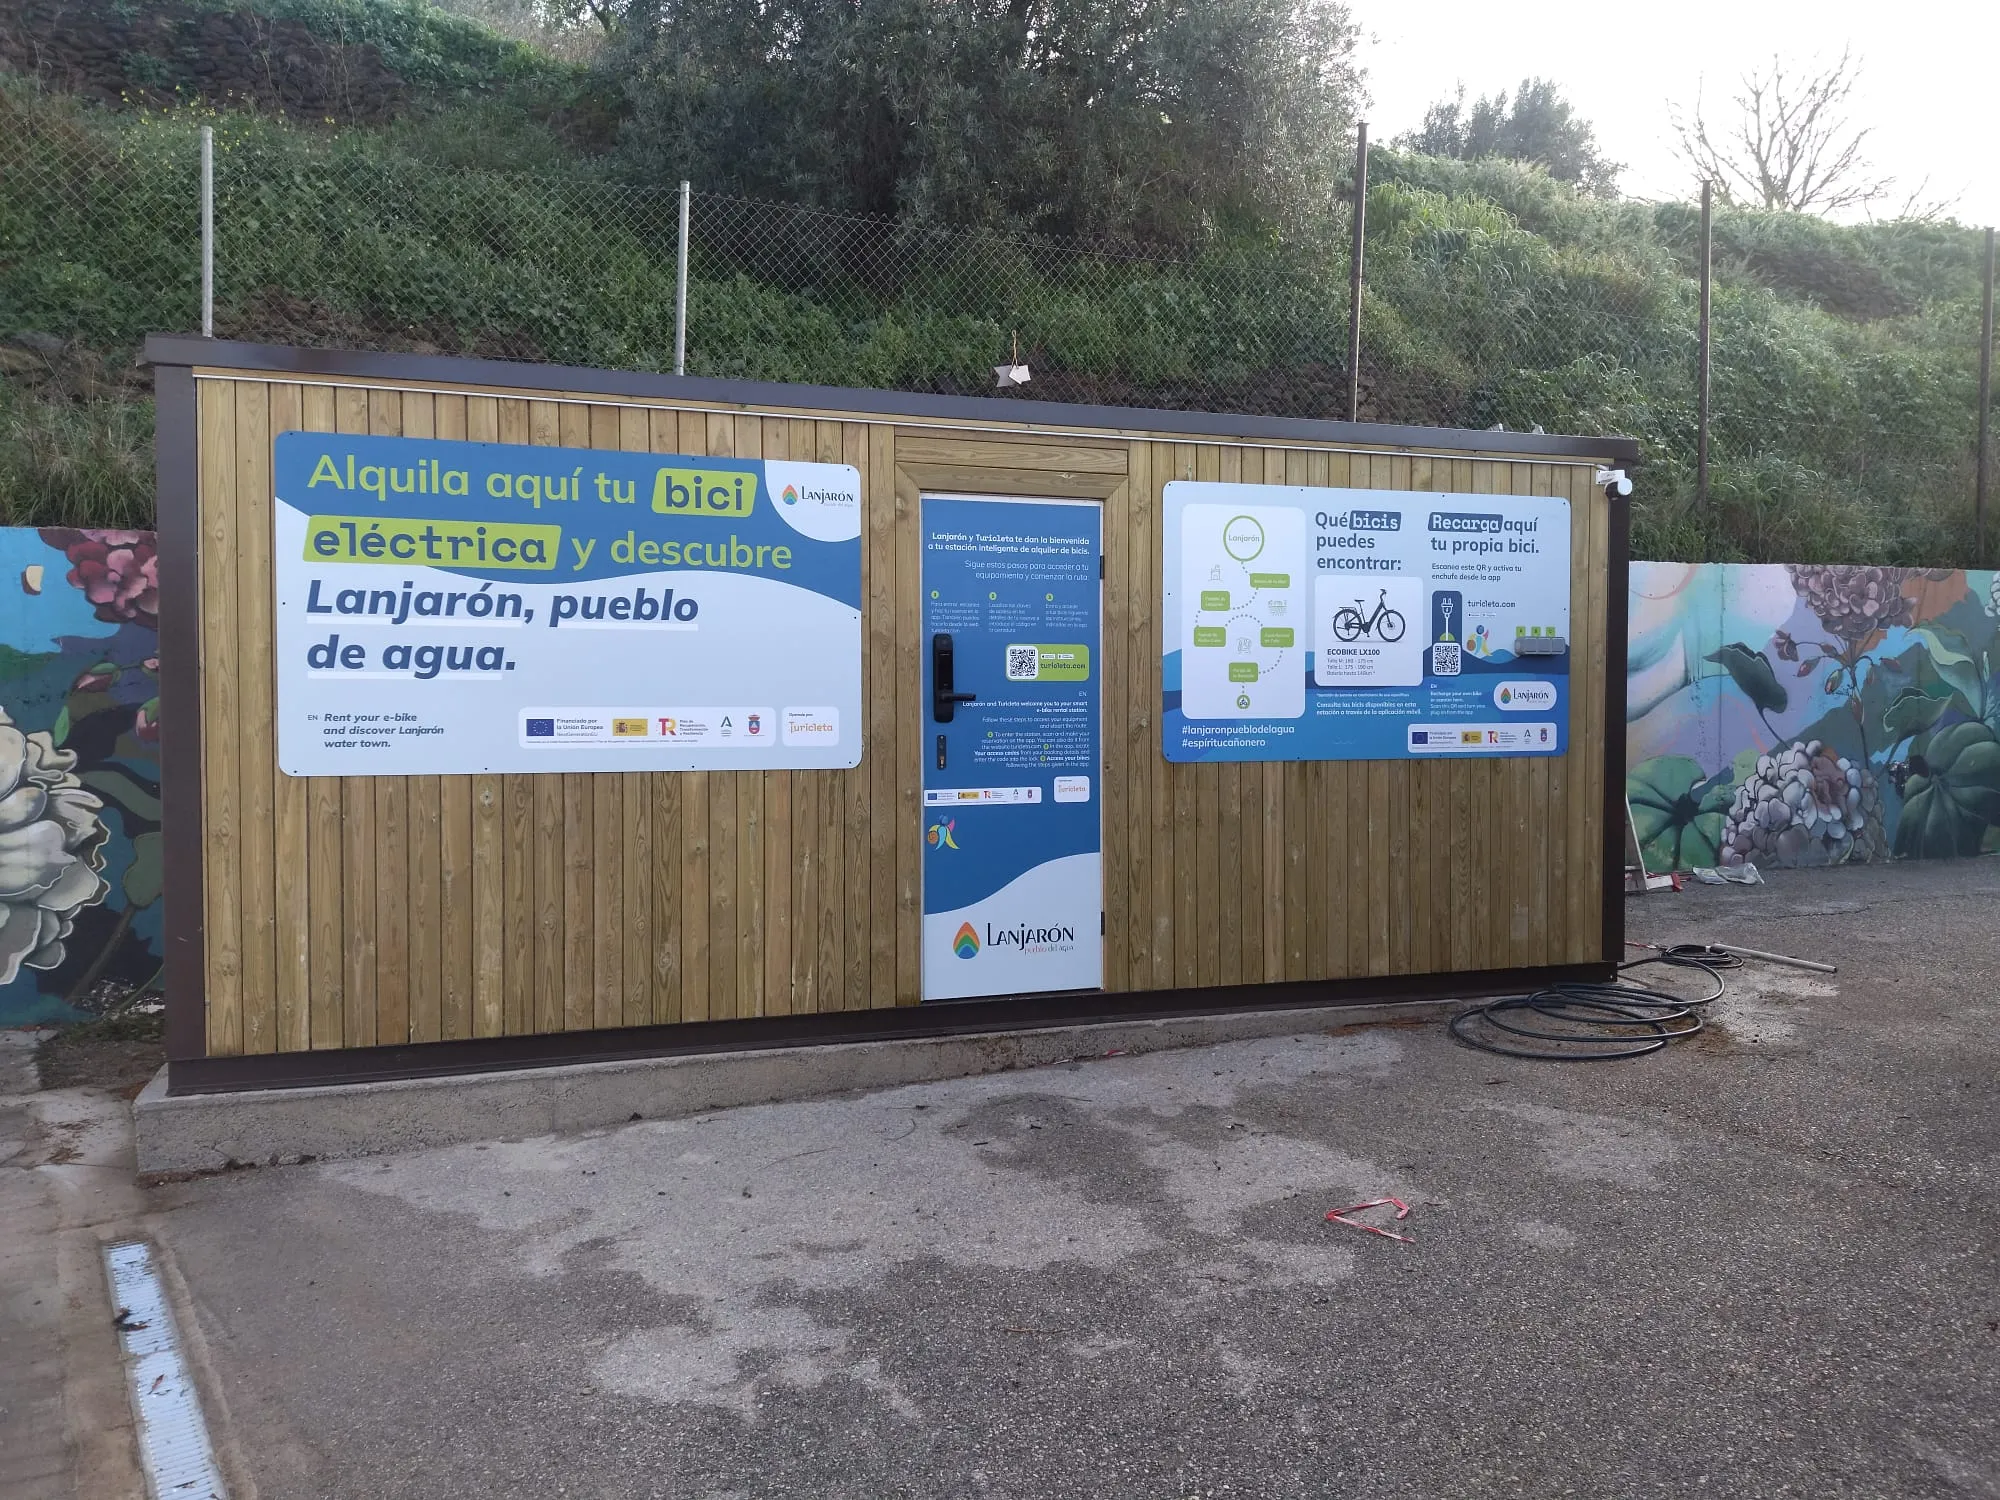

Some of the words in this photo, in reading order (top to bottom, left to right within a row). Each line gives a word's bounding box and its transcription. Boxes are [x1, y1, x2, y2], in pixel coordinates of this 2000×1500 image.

[307, 454, 469, 500] Alquila
[486, 467, 581, 508] aquí
[595, 472, 635, 503] tu
[664, 475, 743, 511] bici
[1315, 512, 1348, 529] Qué
[1353, 513, 1398, 529] bicis
[1432, 514, 1500, 533] Recarga
[1504, 517, 1538, 535] aquí
[932, 532, 967, 541] Lanjarón
[1041, 536, 1047, 544] la
[1049, 537, 1089, 545] bienvenida
[1316, 533, 1375, 551] puedes
[313, 522, 547, 564] eléctrica
[571, 539, 595, 570] y
[610, 530, 792, 569] descubre
[979, 545, 1018, 553] inteligente
[1031, 546, 1059, 555] alquiler
[1431, 537, 1447, 551] tu
[1453, 538, 1503, 555] propia
[1508, 538, 1540, 553] bici.
[964, 560, 985, 569] Sigue
[1317, 556, 1401, 570] encontrar:
[1459, 573, 1479, 581] desde
[1480, 573, 1486, 581] la
[306, 580, 535, 623] Lanjarón,
[549, 587, 698, 627] pueblo
[307, 634, 365, 670] de
[382, 644, 515, 679] agua.
[1327, 648, 1358, 656] ECOBIKE
[1360, 648, 1381, 656] LX100
[324, 713, 351, 721] Rent
[354, 715, 380, 723] your
[383, 713, 417, 721] e-bike
[323, 726, 345, 734] and
[349, 726, 396, 734] discover
[399, 725, 444, 736] Lanjarón
[1182, 725, 1295, 736] #lanjaronpueblodelagua
[324, 740, 357, 748] water
[360, 740, 391, 748] town.
[1182, 738, 1266, 749] #espíritucañonero
